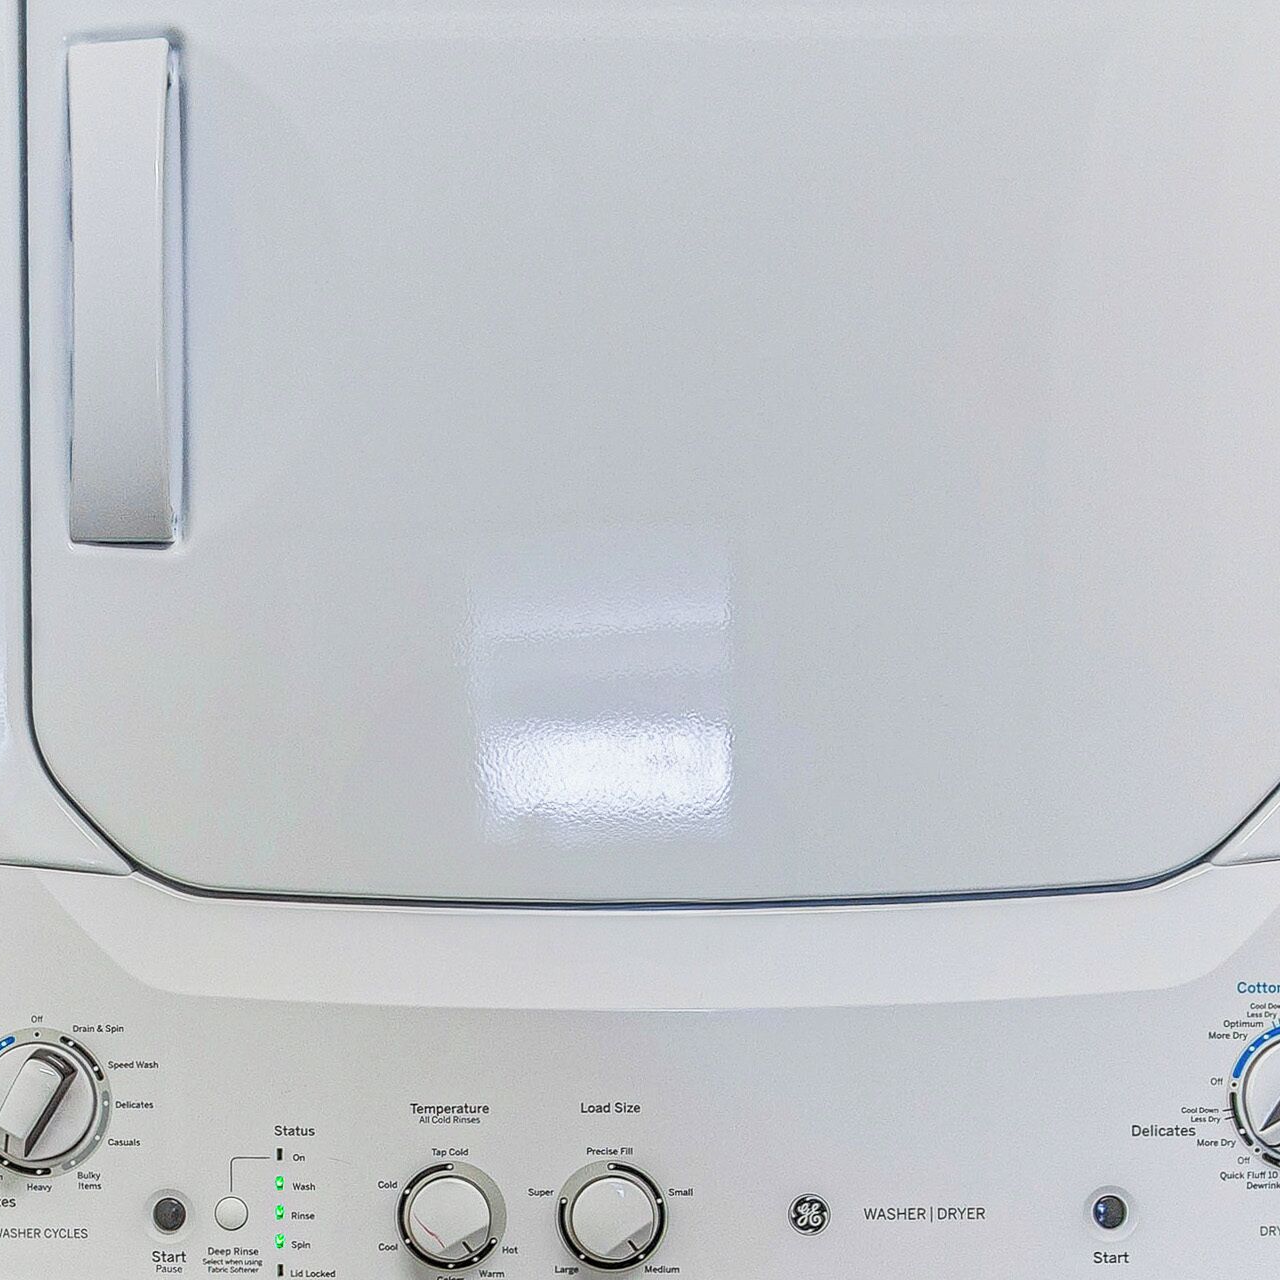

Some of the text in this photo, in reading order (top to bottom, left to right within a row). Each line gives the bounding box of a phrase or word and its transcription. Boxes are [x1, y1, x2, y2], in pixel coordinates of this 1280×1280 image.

[30, 1015, 44, 1024] Off
[72, 1024, 124, 1034] Drain & Spin
[1223, 1020, 1264, 1030] Optimum
[1208, 1032, 1248, 1041] More Dry
[108, 1061, 159, 1071] Speed Wash
[1210, 1077, 1223, 1086] Off
[115, 1101, 154, 1109] Delicates
[410, 1103, 490, 1116] Temperature
[580, 1102, 641, 1113] Load Size
[419, 1116, 481, 1124] All Cold Rinses
[274, 1125, 316, 1137] Status
[1131, 1125, 1196, 1137] Delicates
[107, 1138, 141, 1147] Casuals
[1196, 1139, 1236, 1149] More Dry
[431, 1148, 469, 1158] Tap Cold
[586, 1147, 633, 1155] Precise Fill
[292, 1153, 306, 1162] On
[1237, 1156, 1251, 1165] Off
[77, 1171, 101, 1182] Bulky
[1219, 1171, 1278, 1181] Quick Fluff 10
[26, 1183, 53, 1193] Heavy
[77, 1182, 102, 1190] Items
[292, 1182, 316, 1191] Wash
[377, 1181, 398, 1189] Cold
[528, 1188, 554, 1198] Super
[668, 1188, 694, 1196] Small
[291, 1212, 315, 1220] Rinse
[863, 1207, 986, 1221] WASHER DRYER
[43, 1228, 89, 1239] CYCLES
[291, 1240, 311, 1250] Spin
[378, 1243, 398, 1251] Cool
[207, 1247, 259, 1256] Deep Rinse
[502, 1246, 518, 1254] Hot
[151, 1251, 187, 1263] Start
[1093, 1250, 1130, 1264] Start
[155, 1265, 183, 1273] Pause
[290, 1269, 336, 1278] Lid Locked
[554, 1265, 579, 1275] Large
[644, 1265, 680, 1274] Medium
[479, 1270, 505, 1278] Warm
